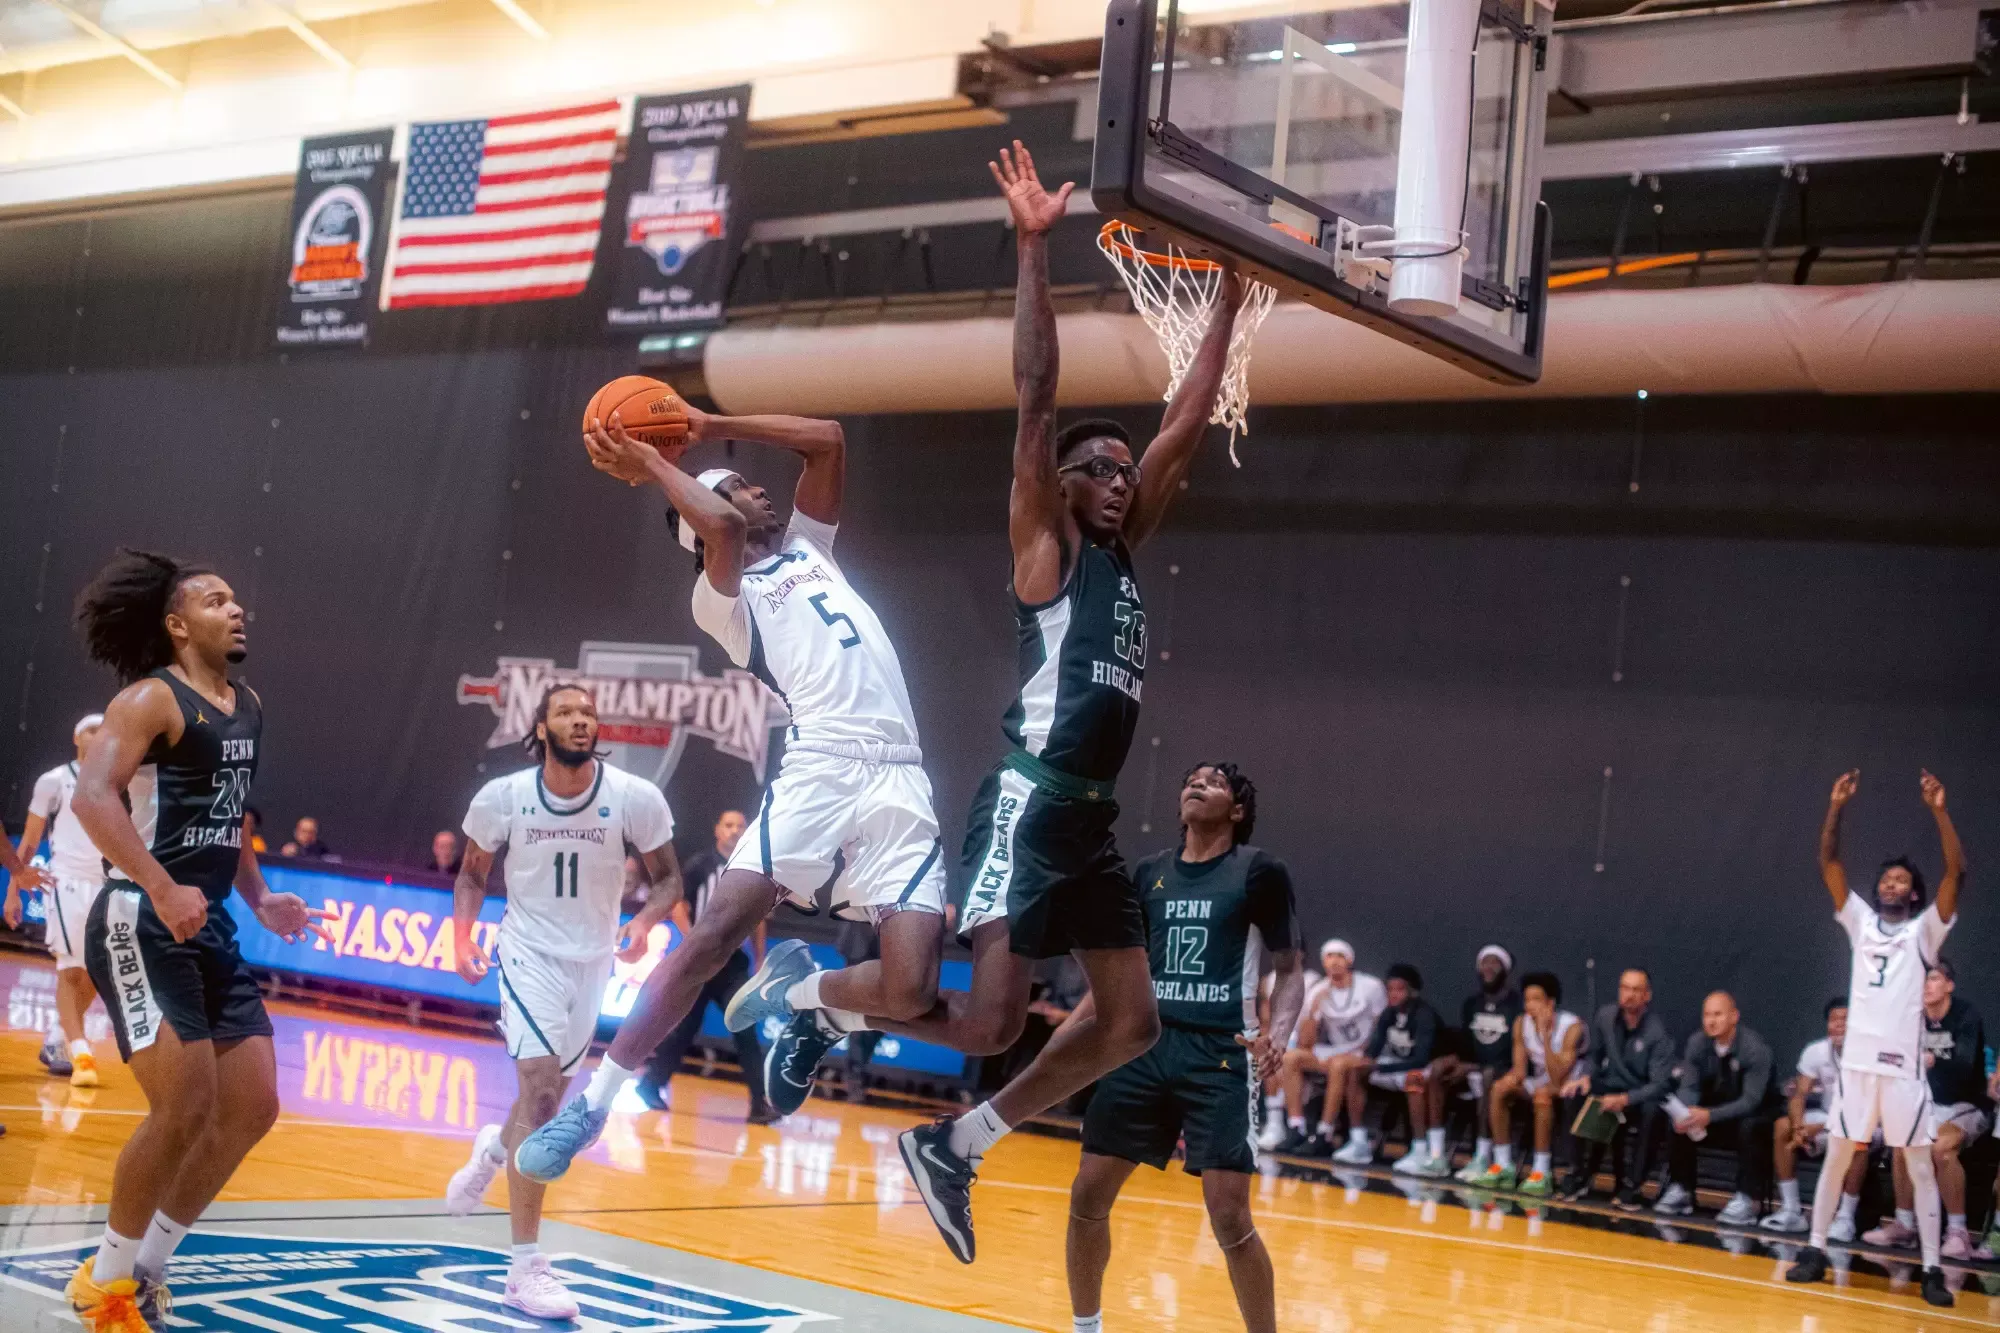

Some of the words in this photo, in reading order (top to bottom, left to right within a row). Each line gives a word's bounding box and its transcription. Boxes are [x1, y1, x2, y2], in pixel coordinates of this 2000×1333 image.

[807, 591, 862, 650] 5
[500, 664, 768, 765] NHAMPTON
[222, 739, 254, 762] PENN
[525, 827, 607, 845] NORTHAMPTON
[992, 796, 1018, 862] BEARS
[553, 851, 579, 898] 11
[1164, 899, 1213, 920] PENN
[110, 922, 140, 976] BEARS
[1164, 925, 1209, 976] 12
[1868, 953, 1890, 988] 3
[121, 977, 150, 1040] BLACK
